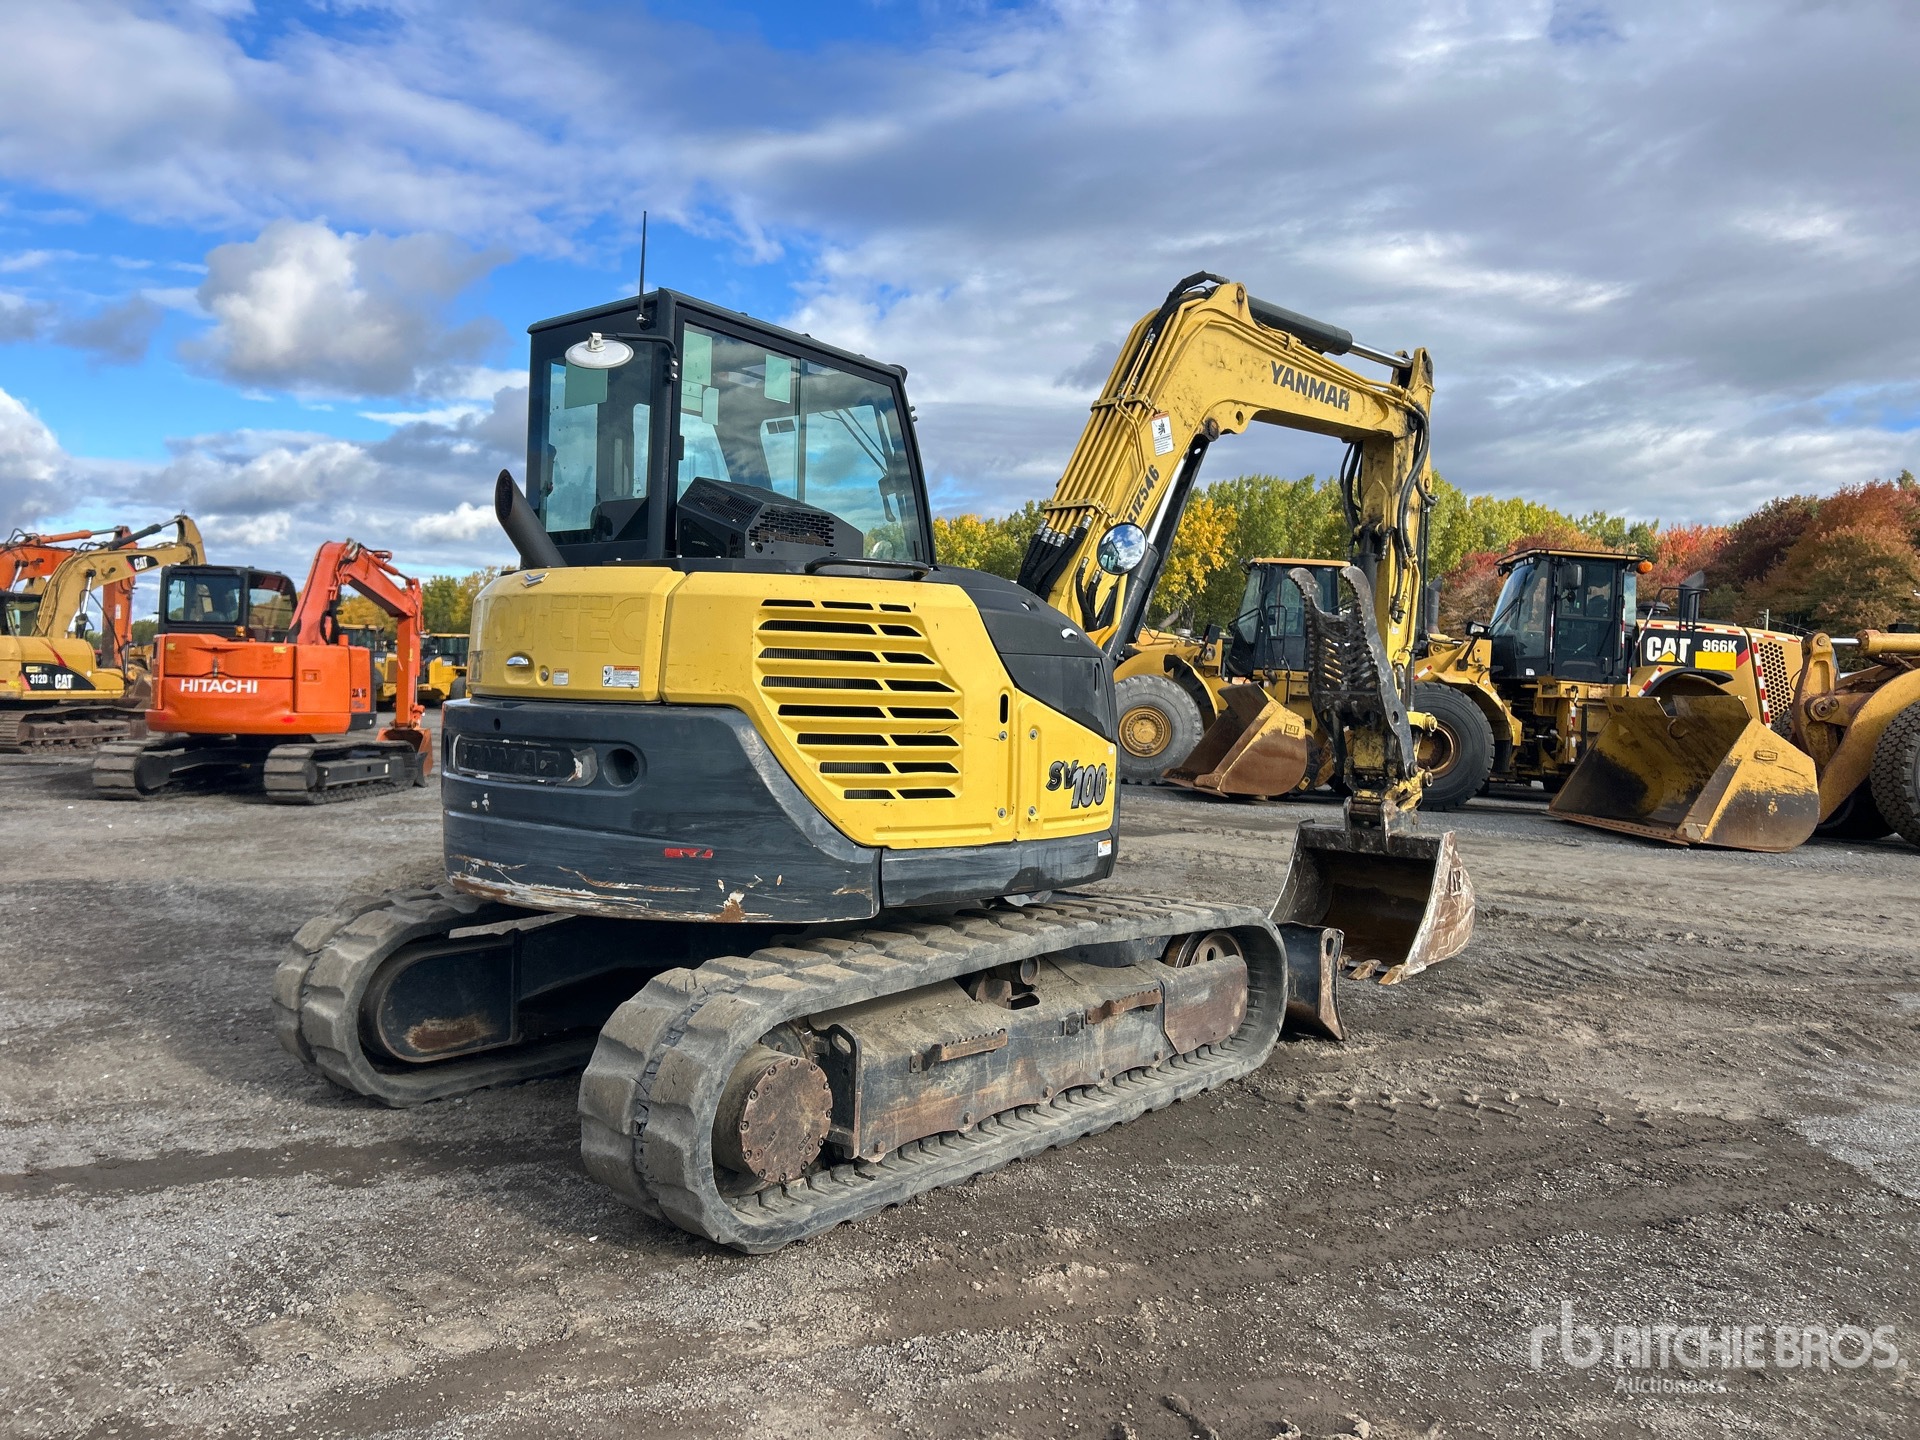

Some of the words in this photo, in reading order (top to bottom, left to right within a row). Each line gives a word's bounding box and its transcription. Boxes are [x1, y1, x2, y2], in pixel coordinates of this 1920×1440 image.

[1271, 360, 1350, 412] YANMAR
[134, 556, 147, 570] CAT
[1646, 636, 1691, 663] CAT
[1702, 639, 1737, 653] 966K
[29, 674, 48, 684] 312D
[54, 674, 73, 689] CAT
[180, 679, 258, 693] HITACHI
